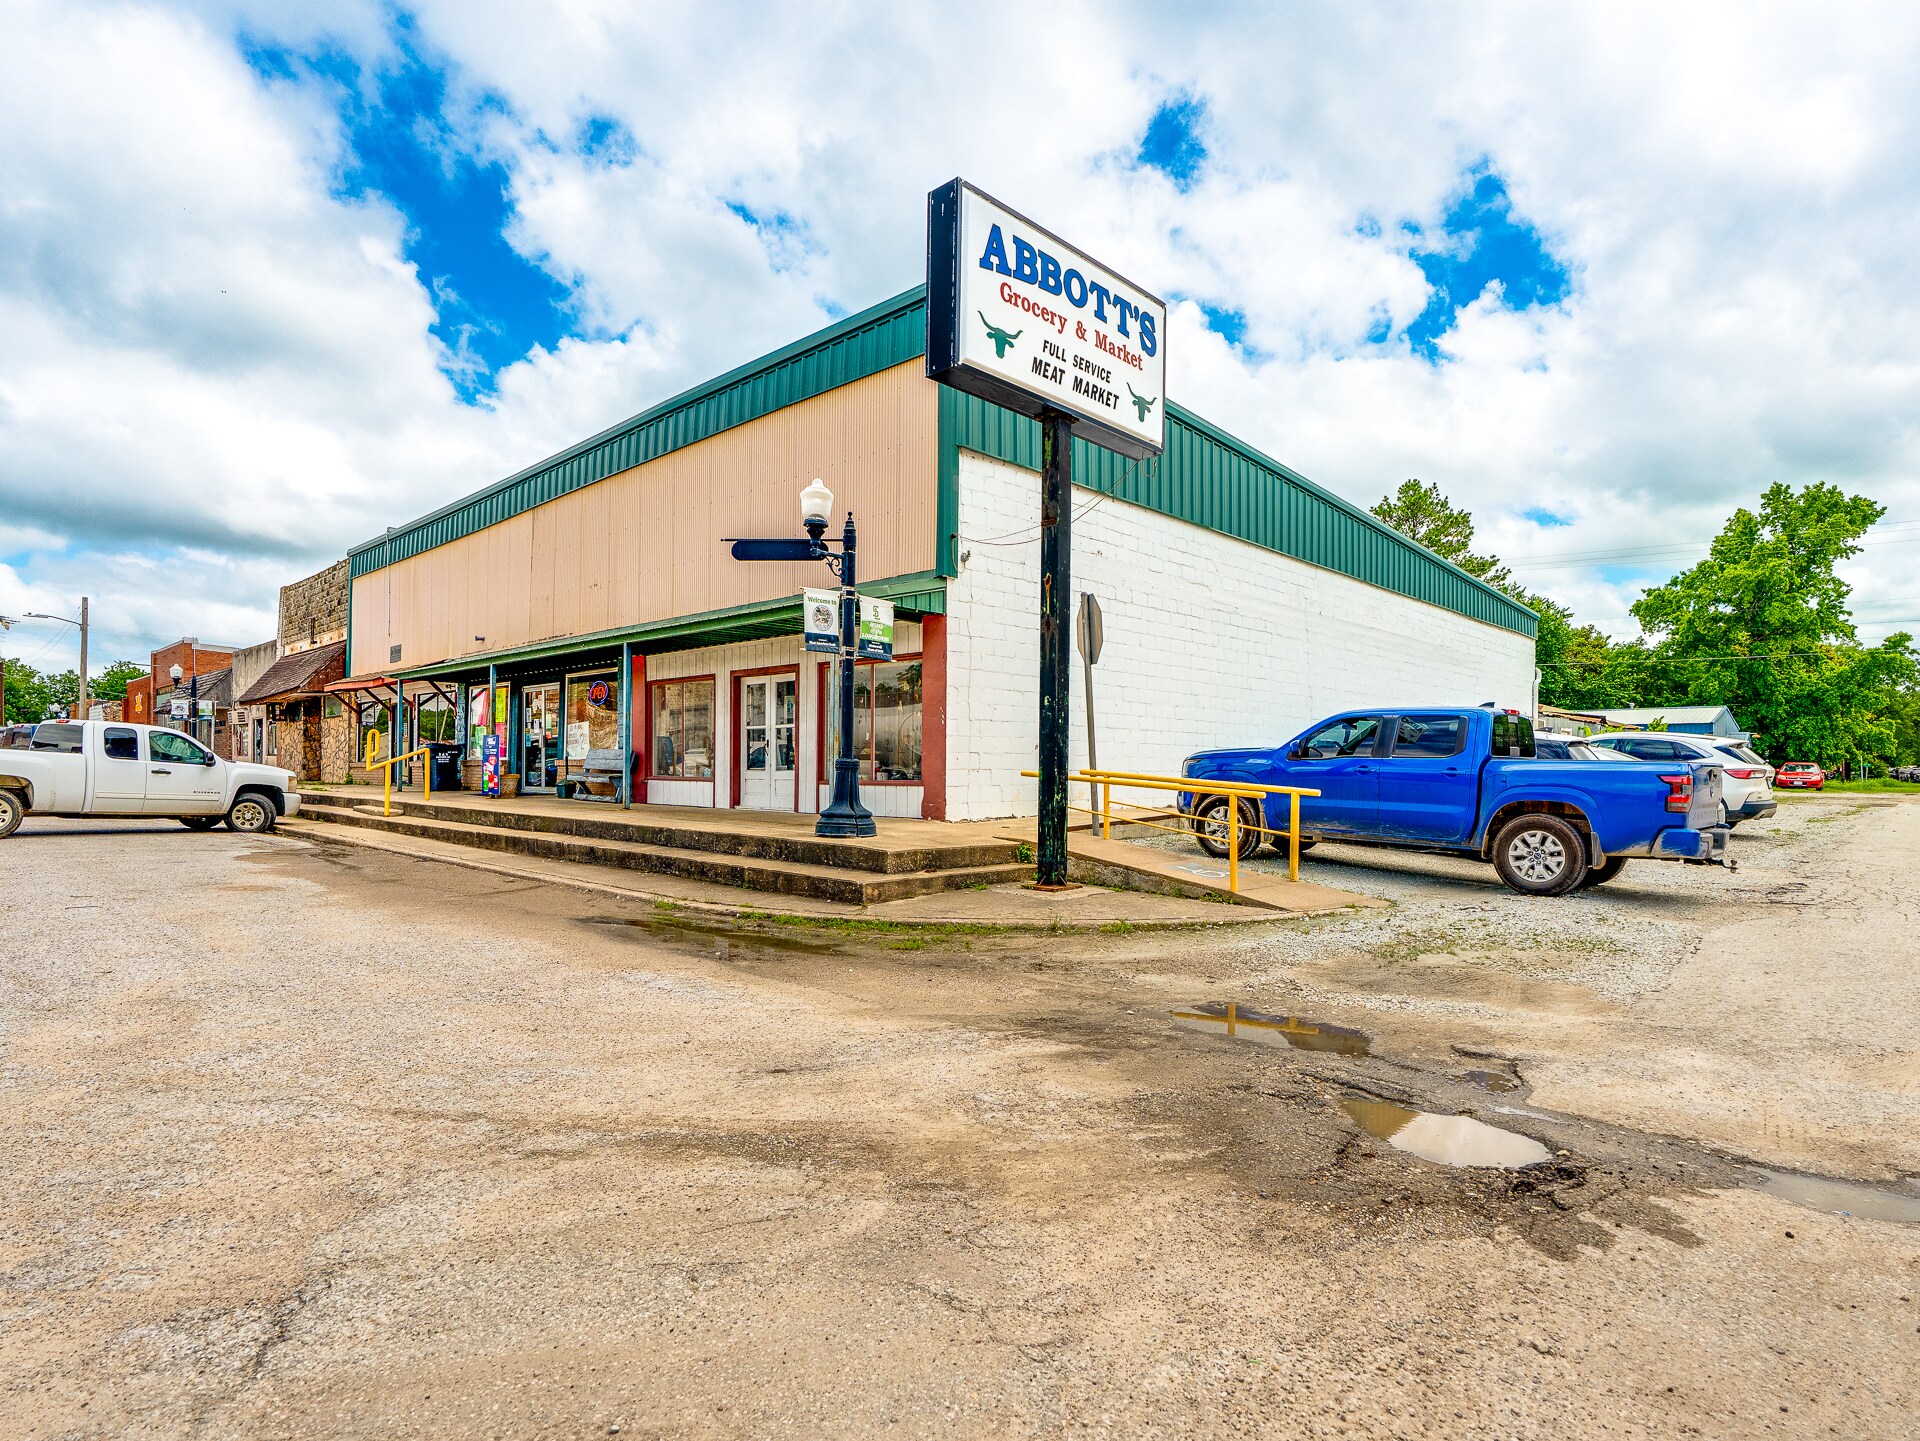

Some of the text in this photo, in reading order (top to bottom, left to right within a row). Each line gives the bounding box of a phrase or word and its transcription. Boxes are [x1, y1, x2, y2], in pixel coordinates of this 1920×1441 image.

[979, 223, 1157, 358] ABBOTT'S
[1000, 282, 1143, 371] Grocery & Market
[1031, 356, 1119, 410] MEAT MARKET
[1042, 339, 1111, 384] FULL SERVICE
[807, 596, 830, 604] Welcome
[590, 686, 607, 700] OPEN
